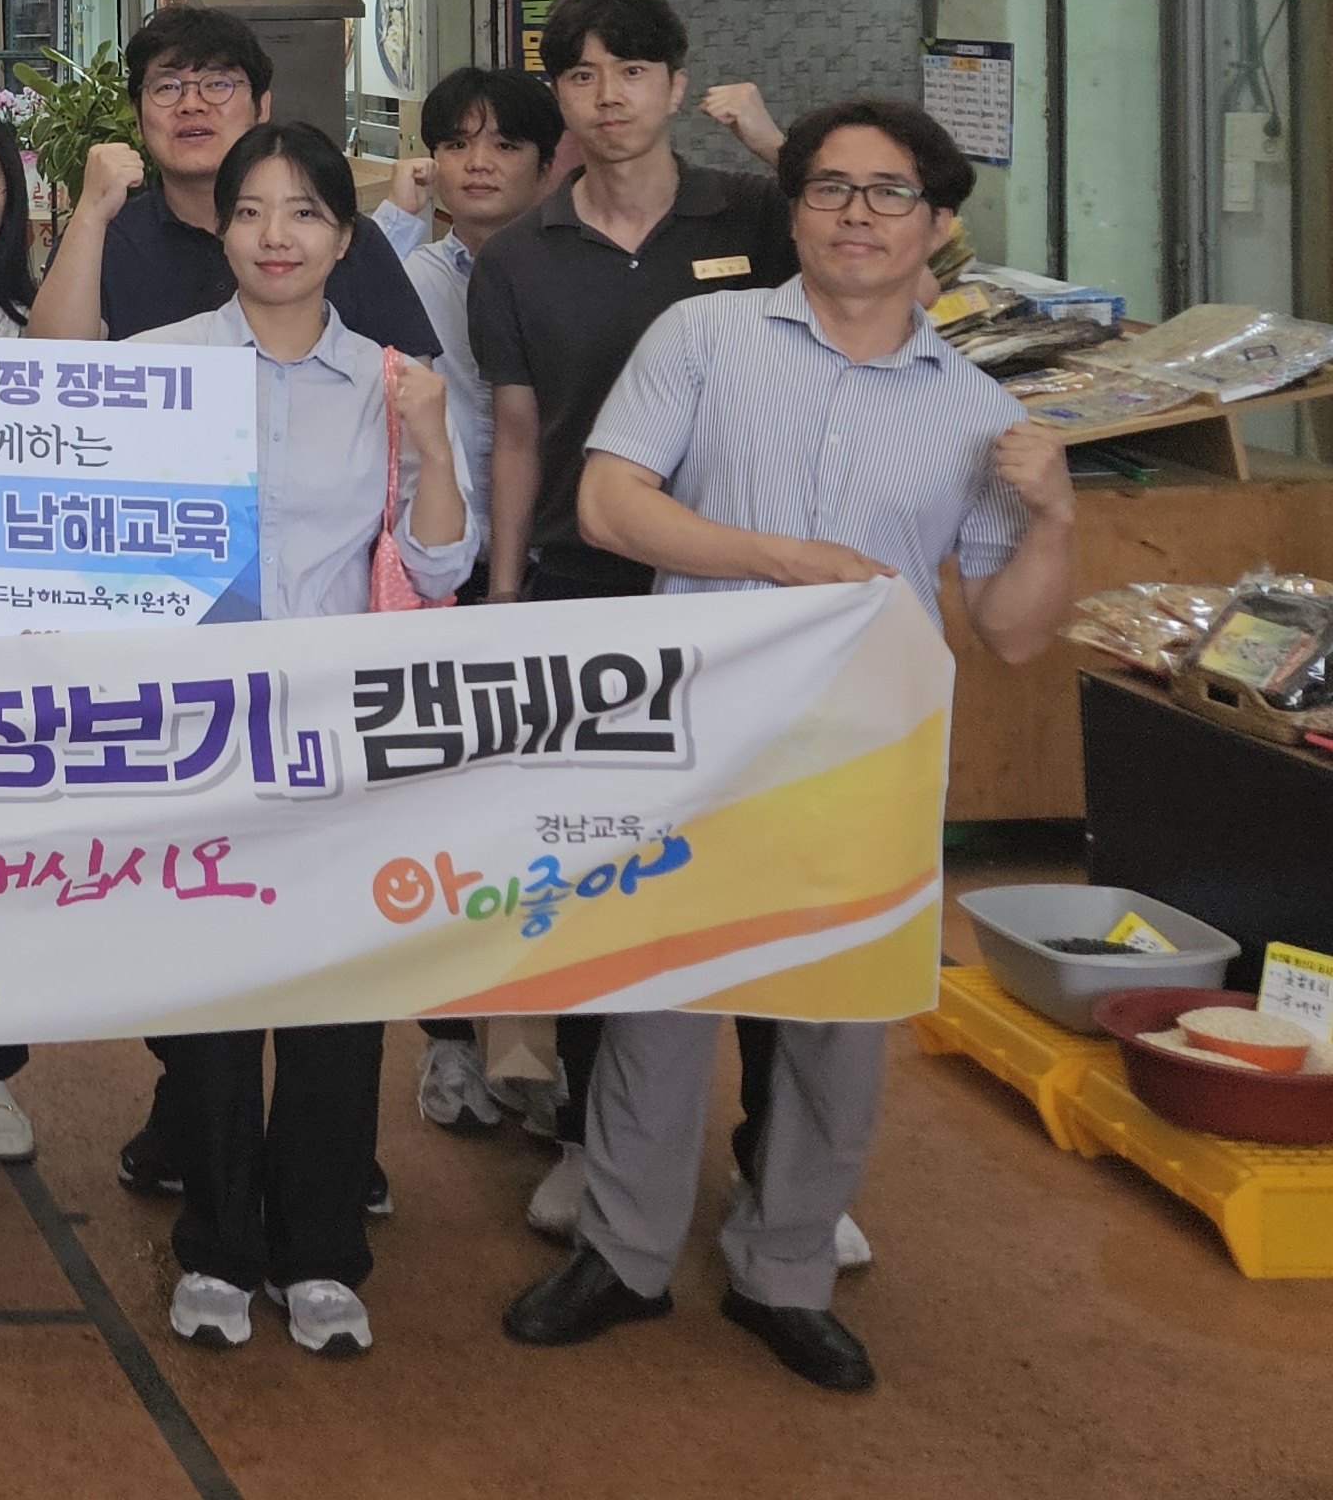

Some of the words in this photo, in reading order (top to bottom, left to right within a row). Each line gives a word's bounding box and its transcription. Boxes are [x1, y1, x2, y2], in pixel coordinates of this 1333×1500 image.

[57, 362, 193, 410] 장보기
[6, 492, 229, 561] 남해교육
[353, 647, 683, 782] 캠페인
[535, 813, 646, 846] 경남교육
[372, 834, 694, 940] 아이좋아
